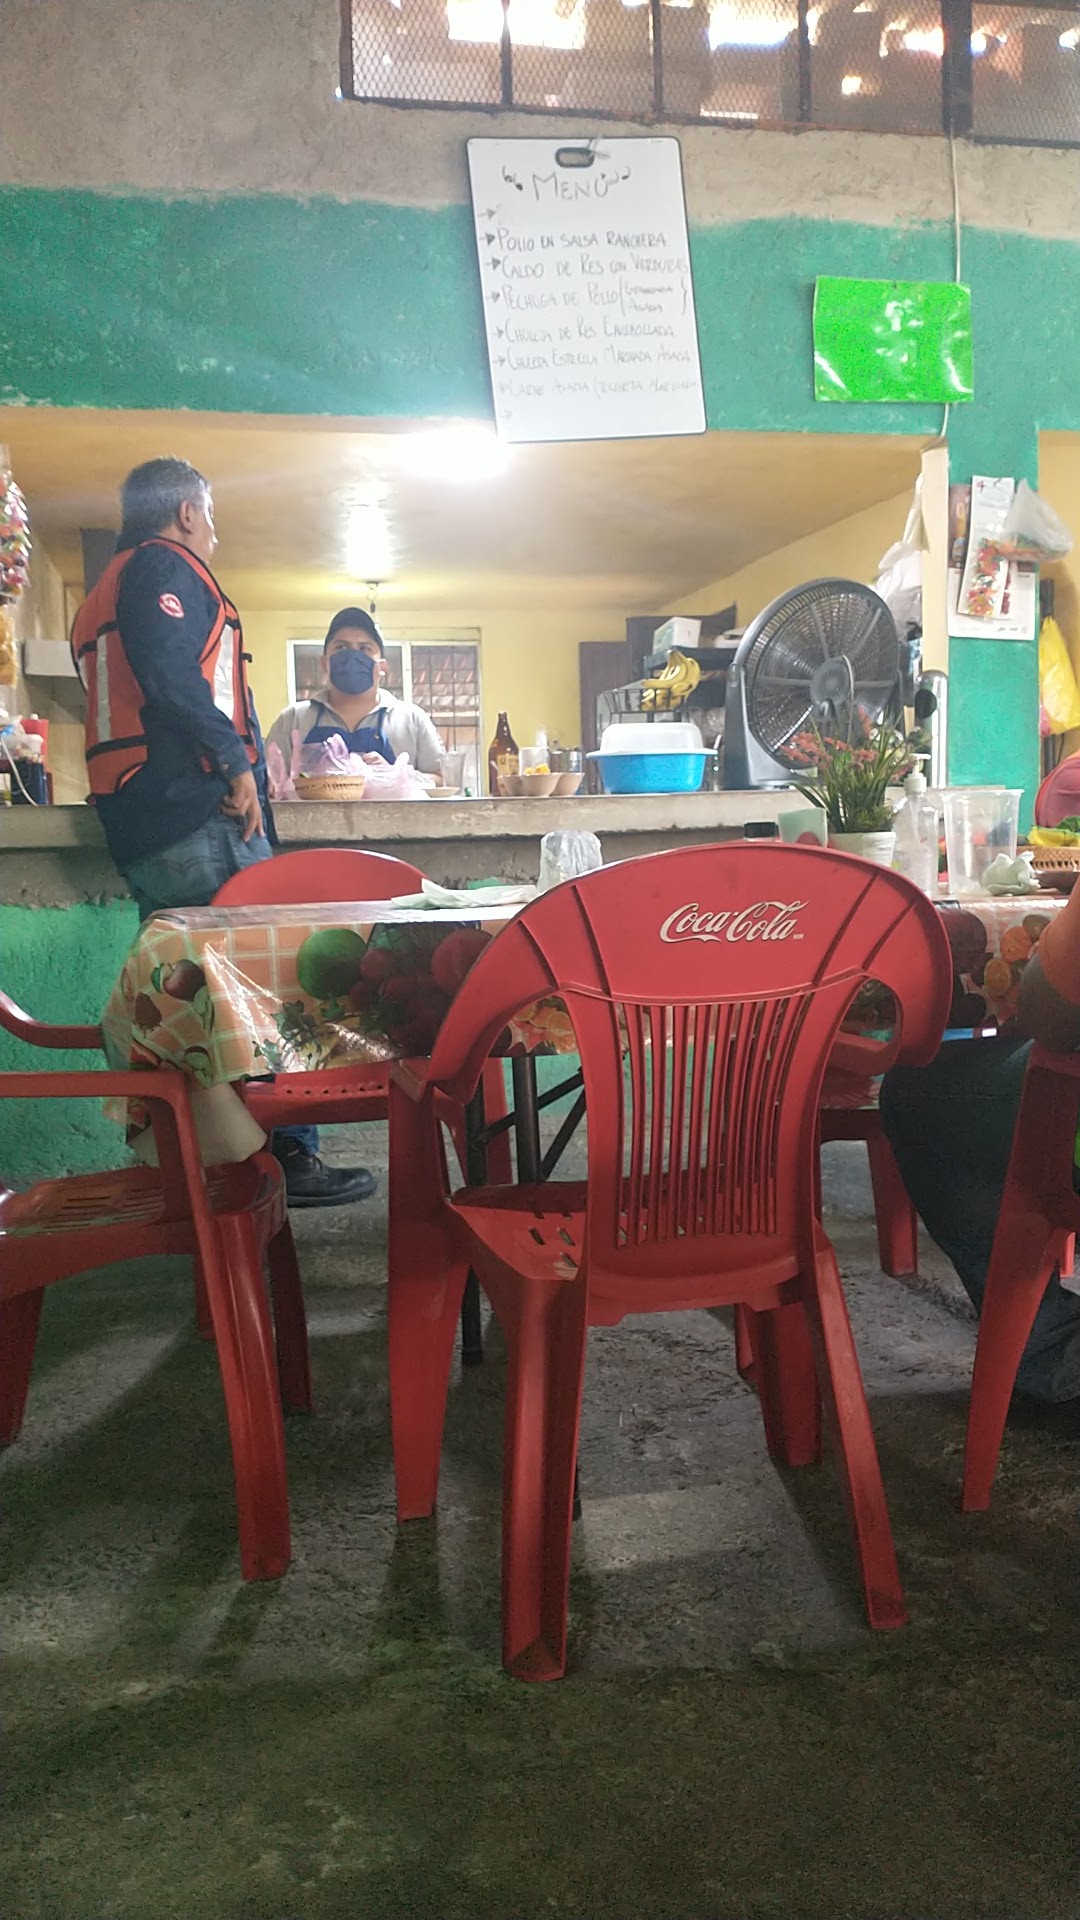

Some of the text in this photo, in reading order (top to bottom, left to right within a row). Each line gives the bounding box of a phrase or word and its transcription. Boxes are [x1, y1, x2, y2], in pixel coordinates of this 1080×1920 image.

[541, 237, 554, 248] EN
[562, 234, 599, 248] SALSA
[606, 231, 667, 248] RANCHERA
[502, 252, 689, 279] CALDO DE RES CON VERDURAS
[502, 282, 618, 311] PECHUGA DE POLLO
[505, 317, 553, 344] CHULETA
[559, 326, 573, 341] DE
[576, 316, 597, 338] RES
[506, 345, 549, 371] CHULETA
[659, 900, 809, 944] Coca-Cola
